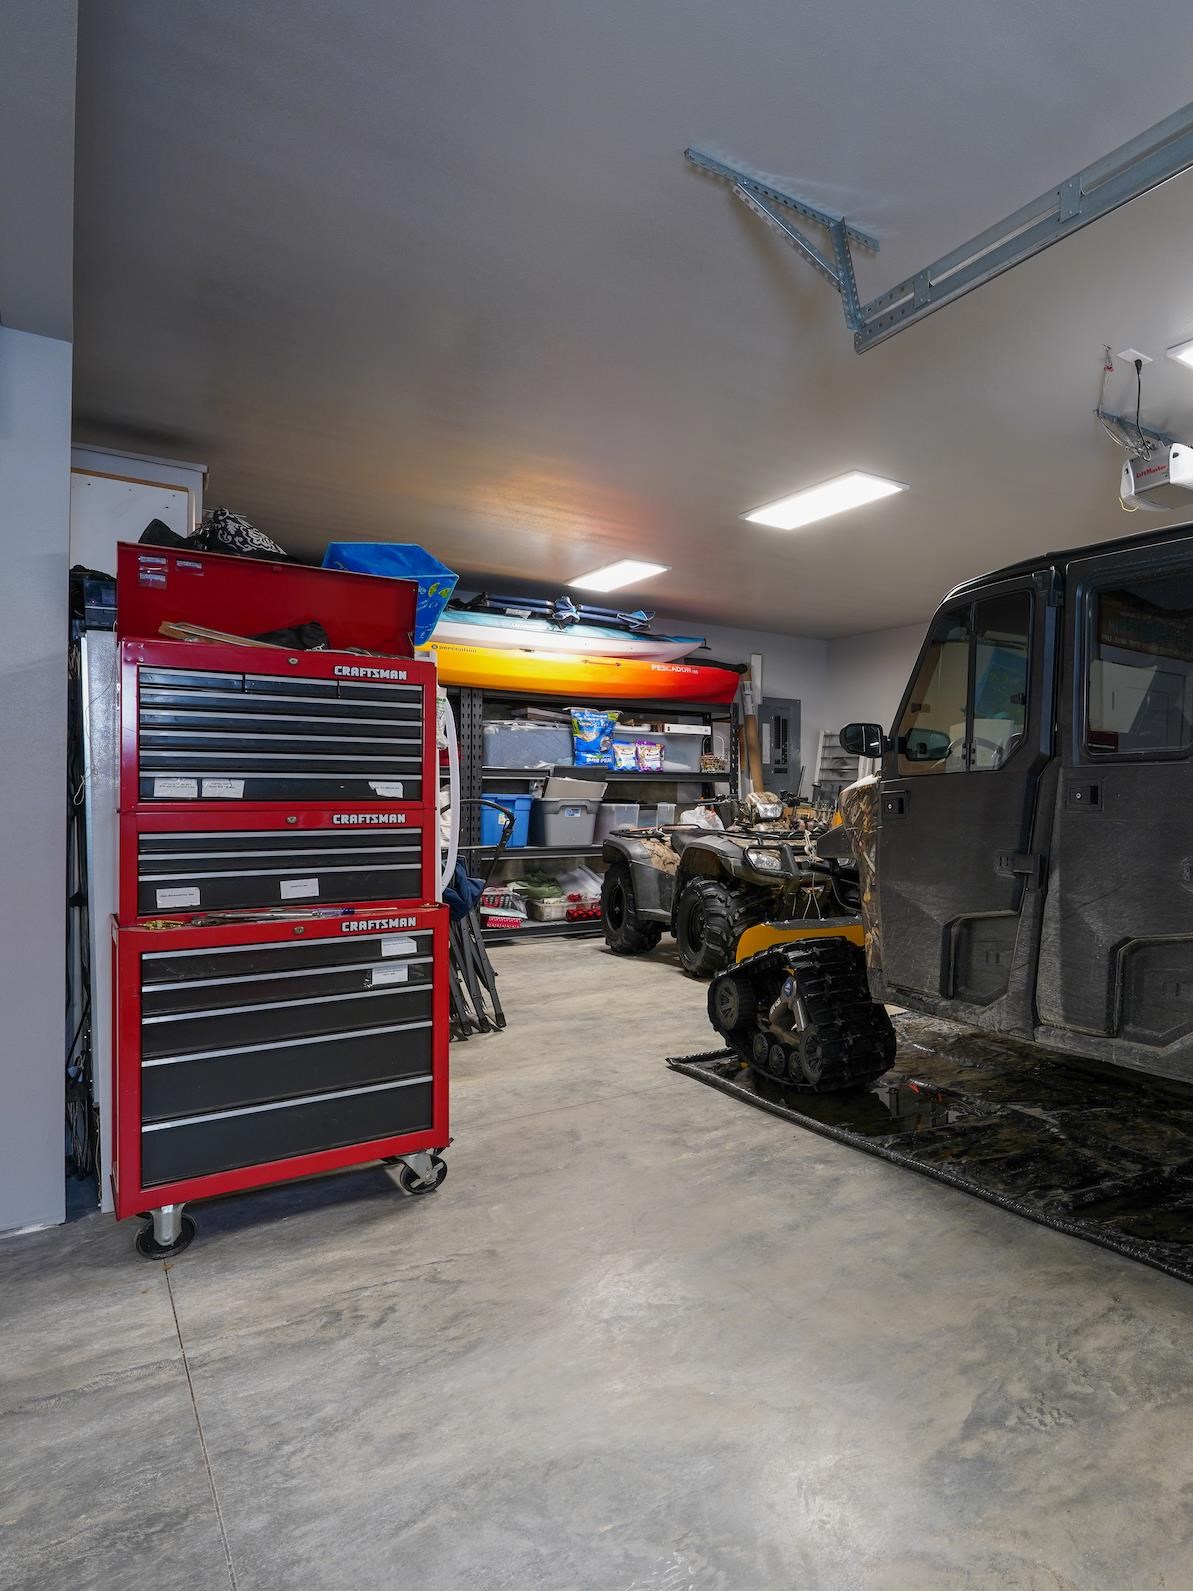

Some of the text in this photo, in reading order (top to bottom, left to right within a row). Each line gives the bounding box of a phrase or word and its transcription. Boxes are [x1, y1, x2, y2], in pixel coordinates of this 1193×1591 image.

[334, 665, 407, 681] CRAFTSMAN
[651, 664, 692, 674] PESCADOR
[333, 813, 406, 825] CRAFTSMAN
[341, 917, 417, 932] CRAFTSMAN
